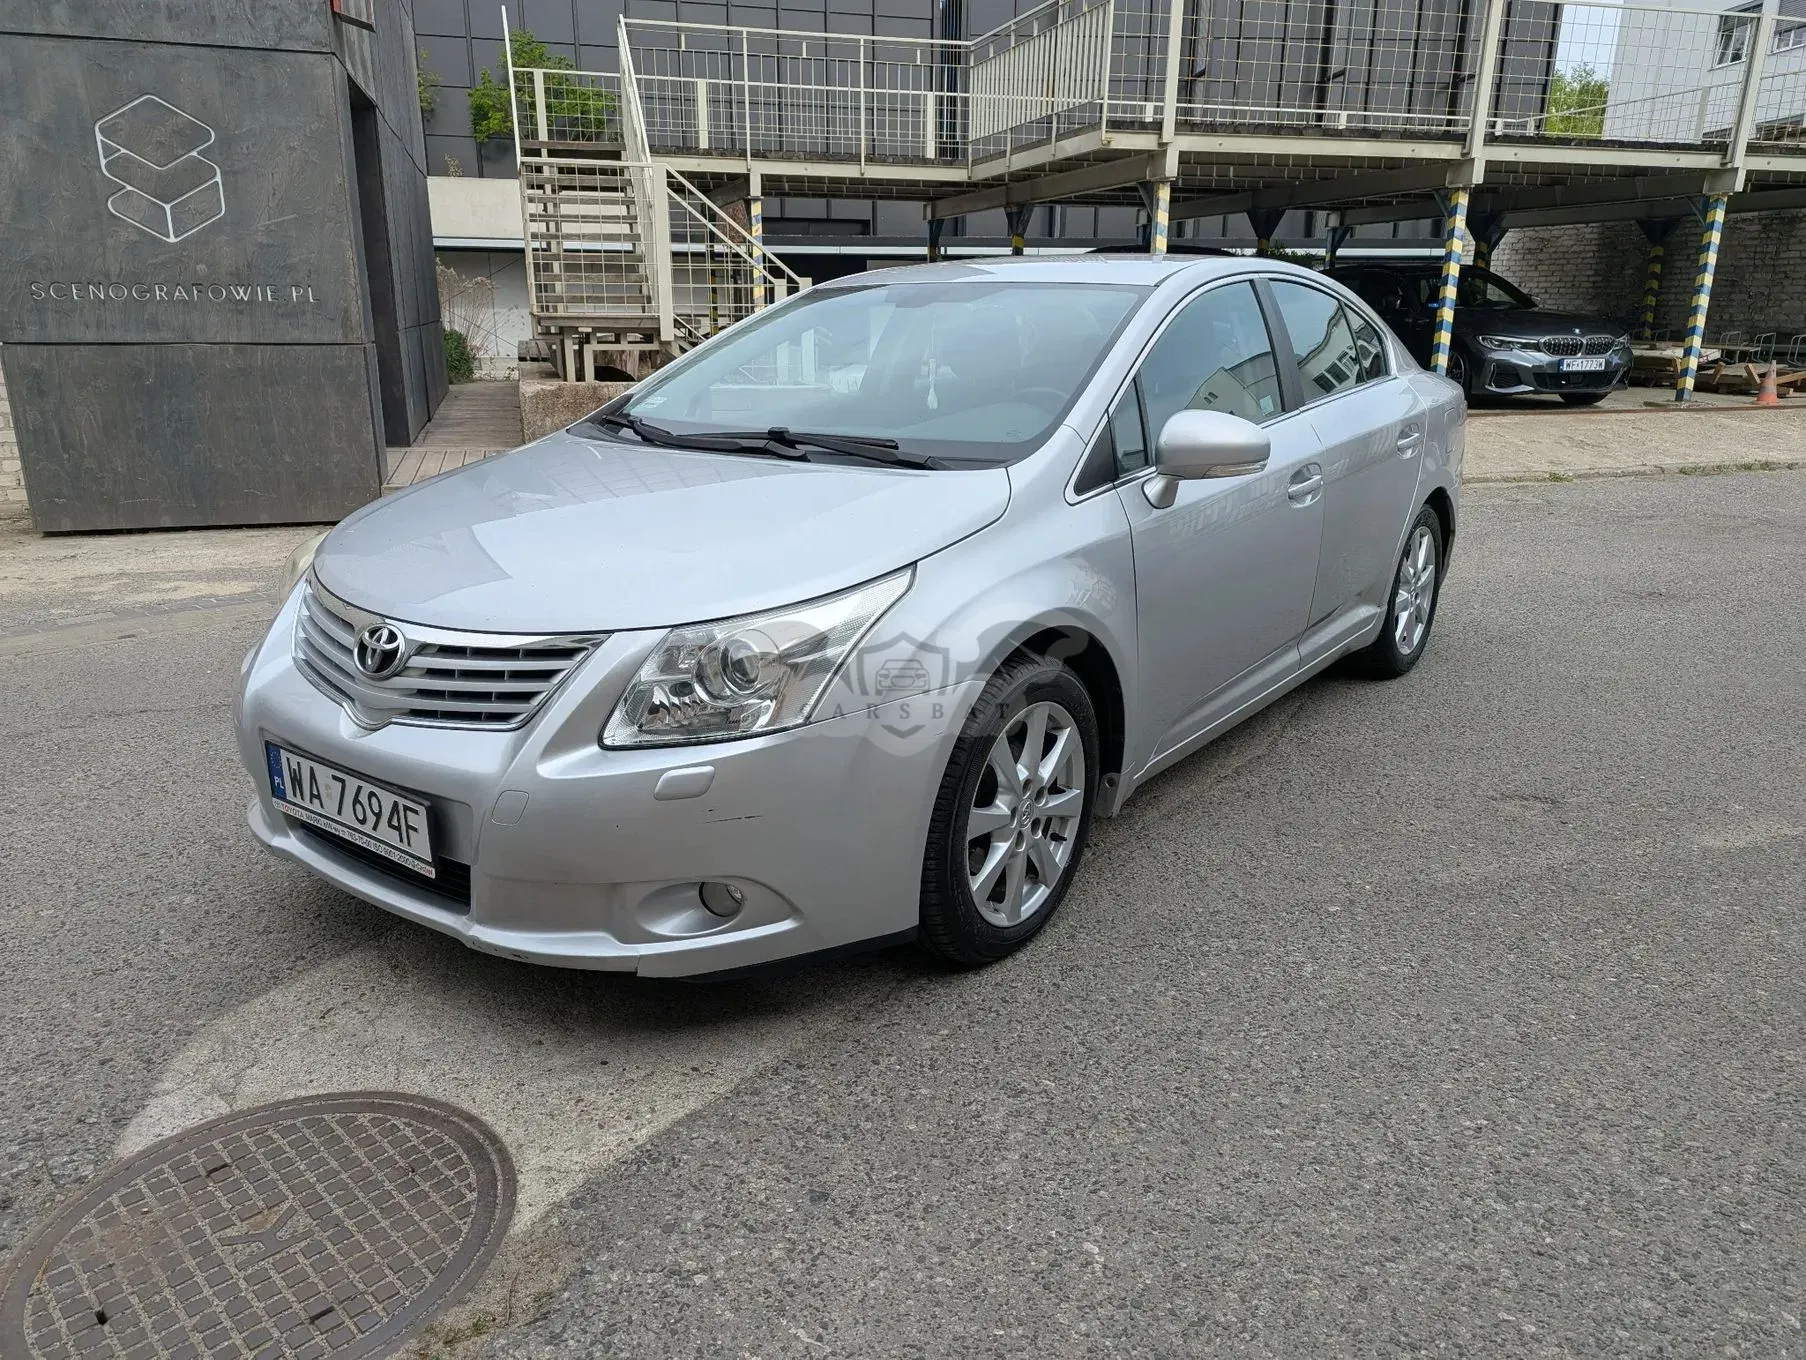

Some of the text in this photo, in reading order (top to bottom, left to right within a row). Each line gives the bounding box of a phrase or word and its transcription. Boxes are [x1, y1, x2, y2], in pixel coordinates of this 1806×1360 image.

[29, 281, 320, 303] SCENOGRAFOWIE.PL
[273, 775, 285, 789] PL
[286, 756, 420, 848] WA 7694F
